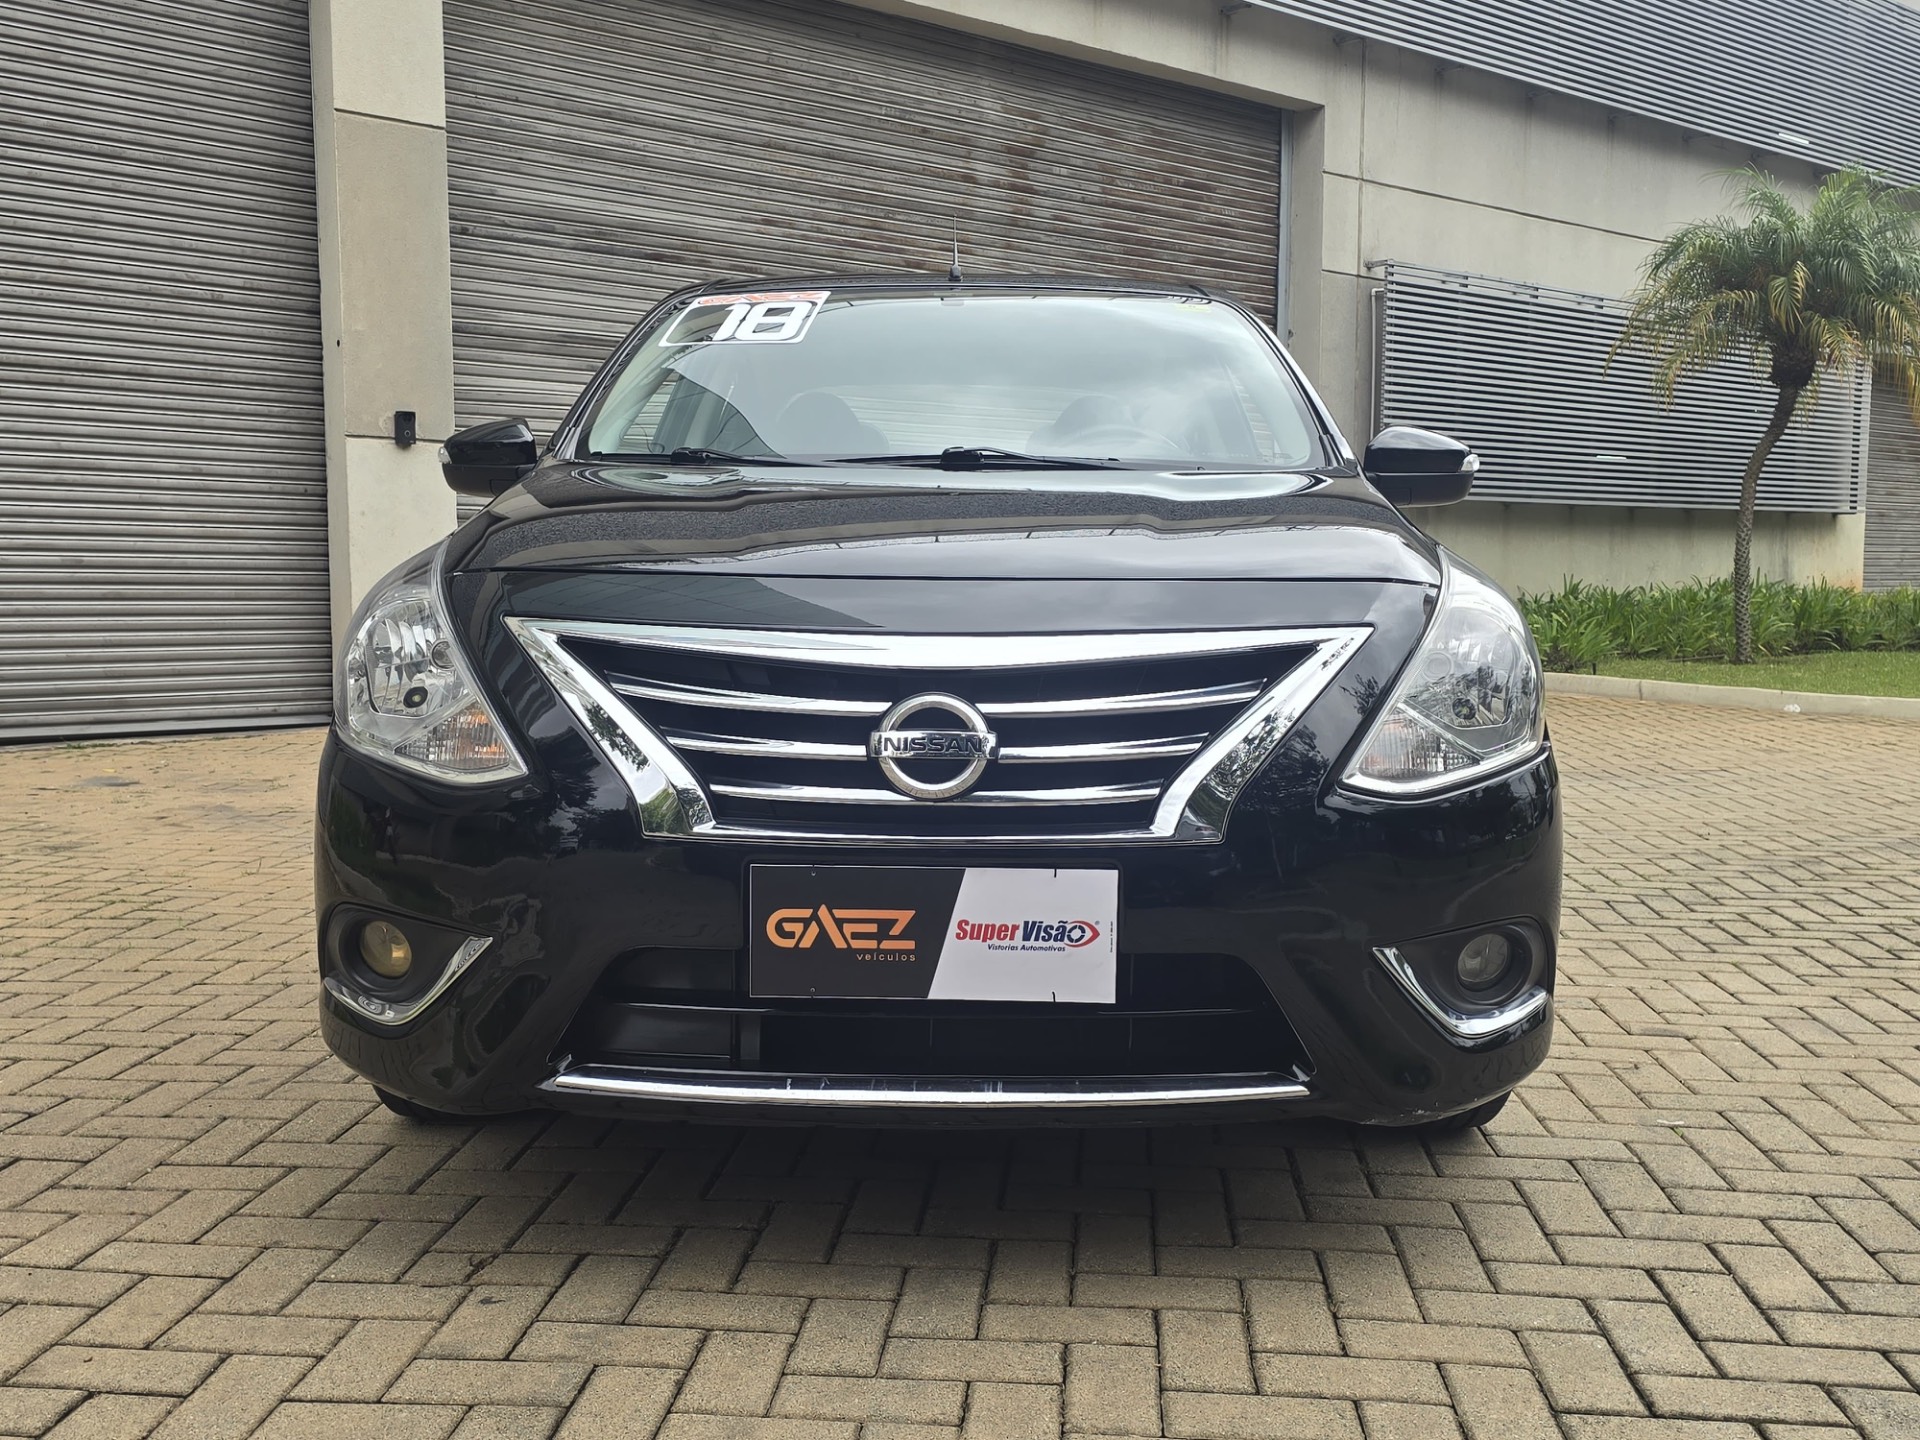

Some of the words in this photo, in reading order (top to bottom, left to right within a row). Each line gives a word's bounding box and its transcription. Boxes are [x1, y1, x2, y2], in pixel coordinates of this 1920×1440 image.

[712, 302, 812, 341] 18
[883, 736, 983, 754] NISSAN
[766, 903, 916, 949] GAEZ
[987, 943, 1019, 952] Vistorias
[1019, 944, 1067, 953] Automotivas
